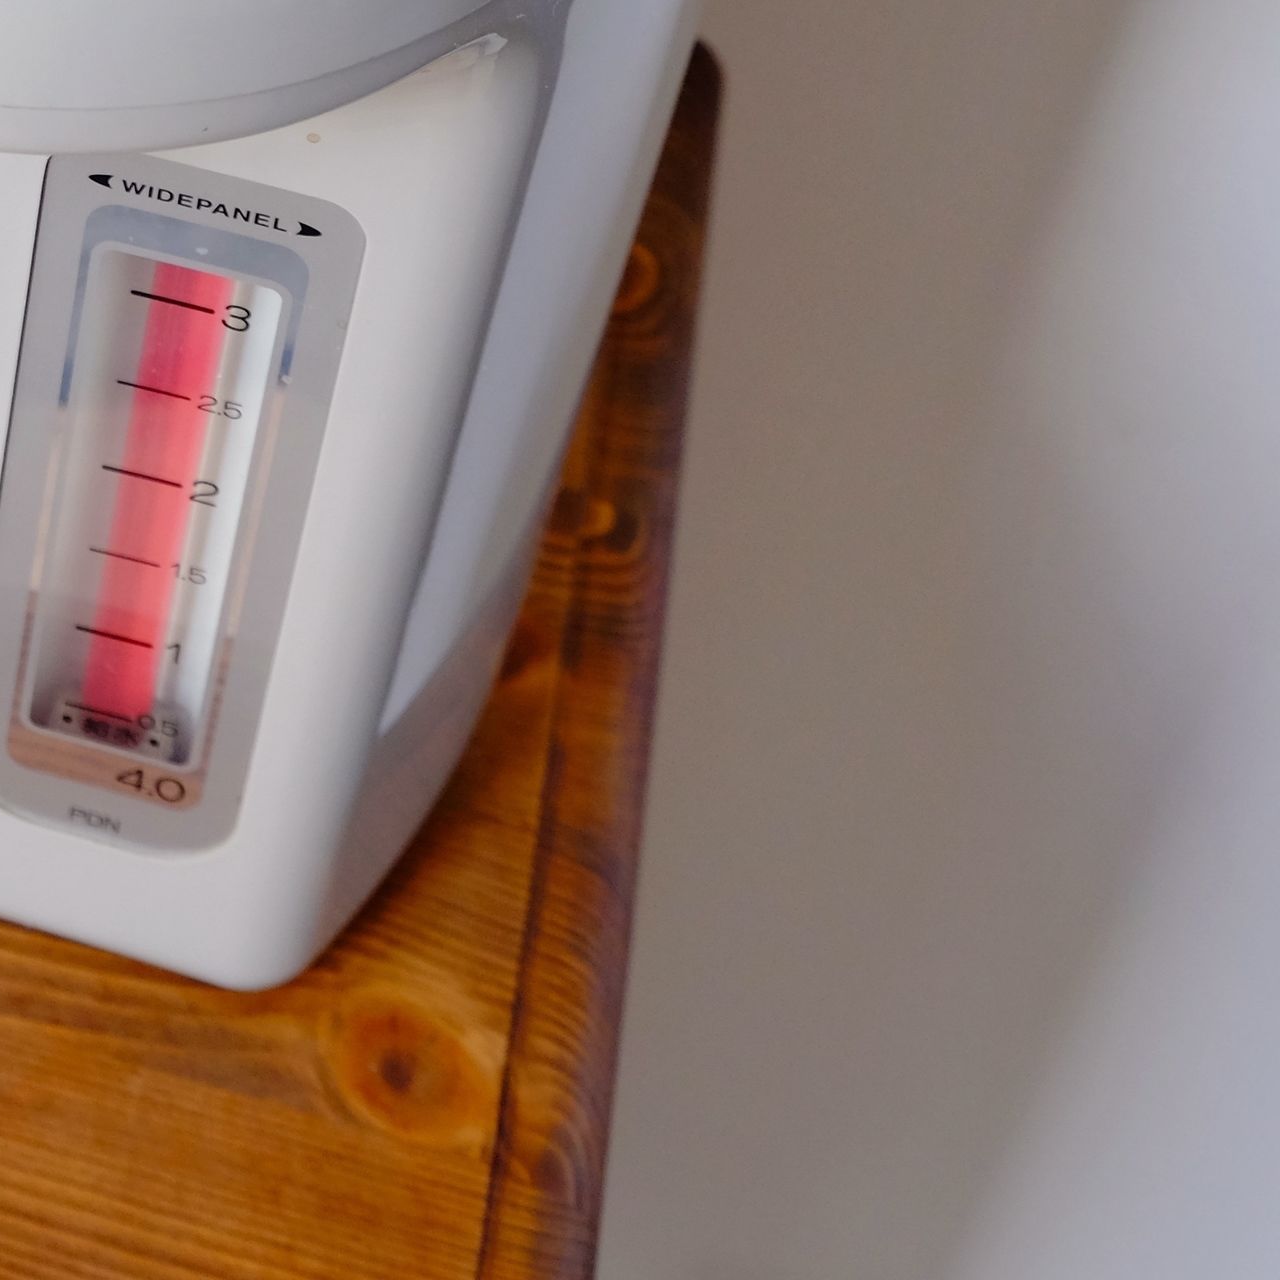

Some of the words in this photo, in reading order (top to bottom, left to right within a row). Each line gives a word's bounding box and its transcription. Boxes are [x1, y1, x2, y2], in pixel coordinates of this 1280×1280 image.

[122, 178, 288, 233] WIDEPANEL
[221, 304, 252, 332] 3
[196, 395, 243, 421] 2.5
[188, 480, 220, 507] 2
[170, 562, 207, 585] 1.5
[166, 642, 182, 665] 1
[116, 769, 186, 803] 4.0
[69, 806, 122, 833] PDN
